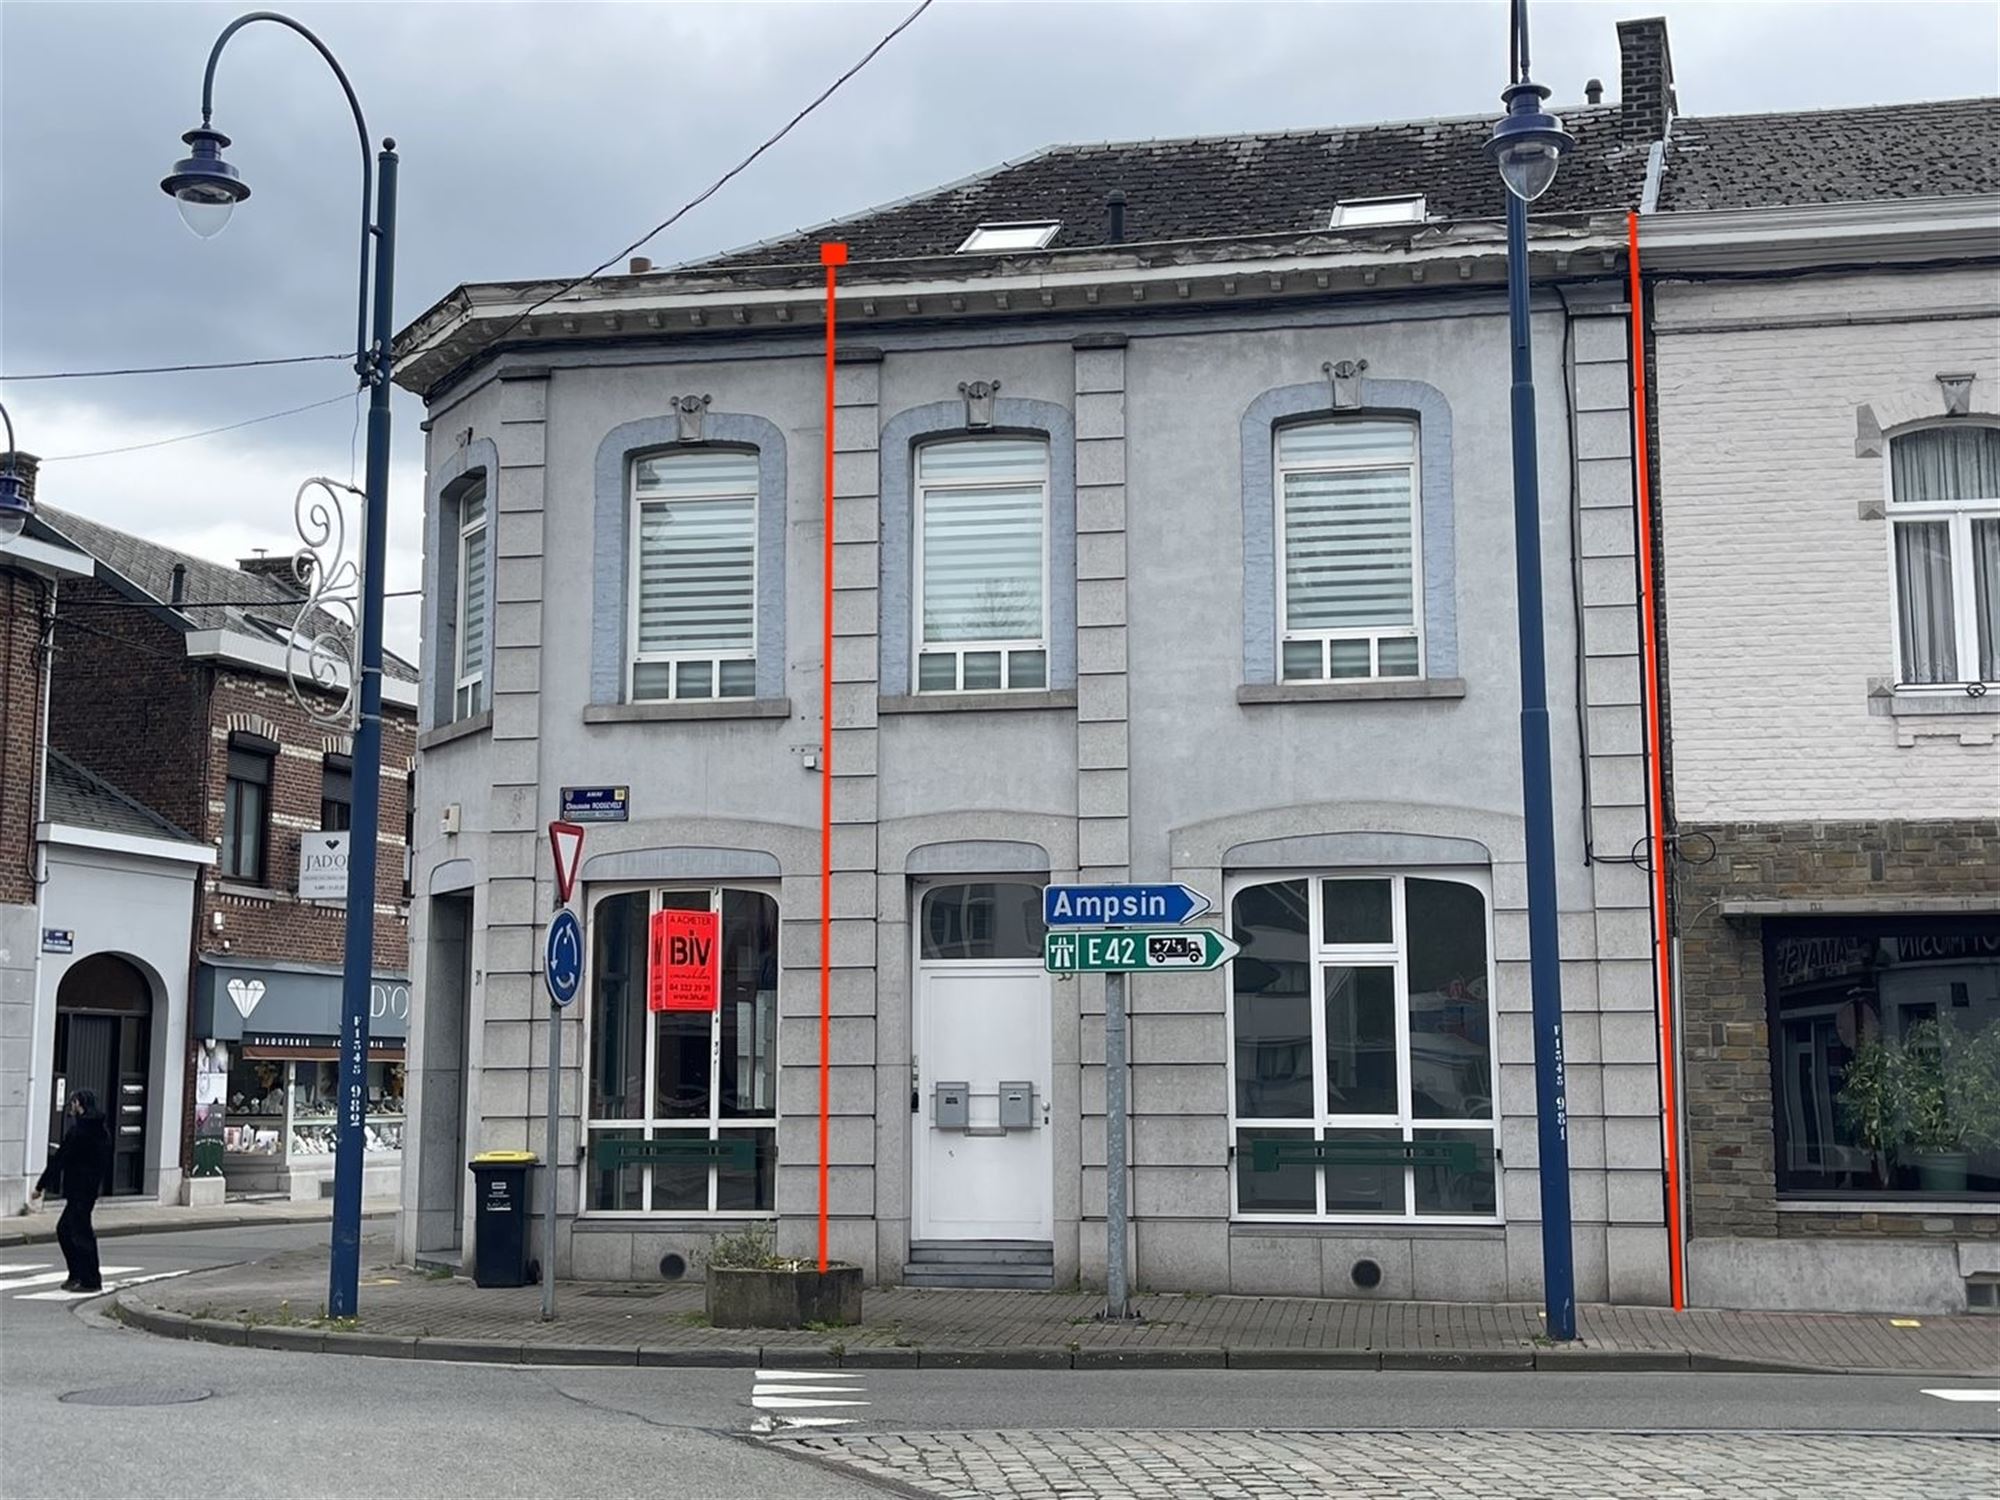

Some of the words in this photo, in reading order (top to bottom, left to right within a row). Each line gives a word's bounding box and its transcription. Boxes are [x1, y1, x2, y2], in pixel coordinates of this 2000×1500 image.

[1053, 890, 1166, 922] Ampsin
[677, 916, 711, 926] ACHETER
[1088, 938, 1102, 965] E
[1105, 938, 1136, 964] 42
[254, 1037, 310, 1047] BIJOUTERIE
